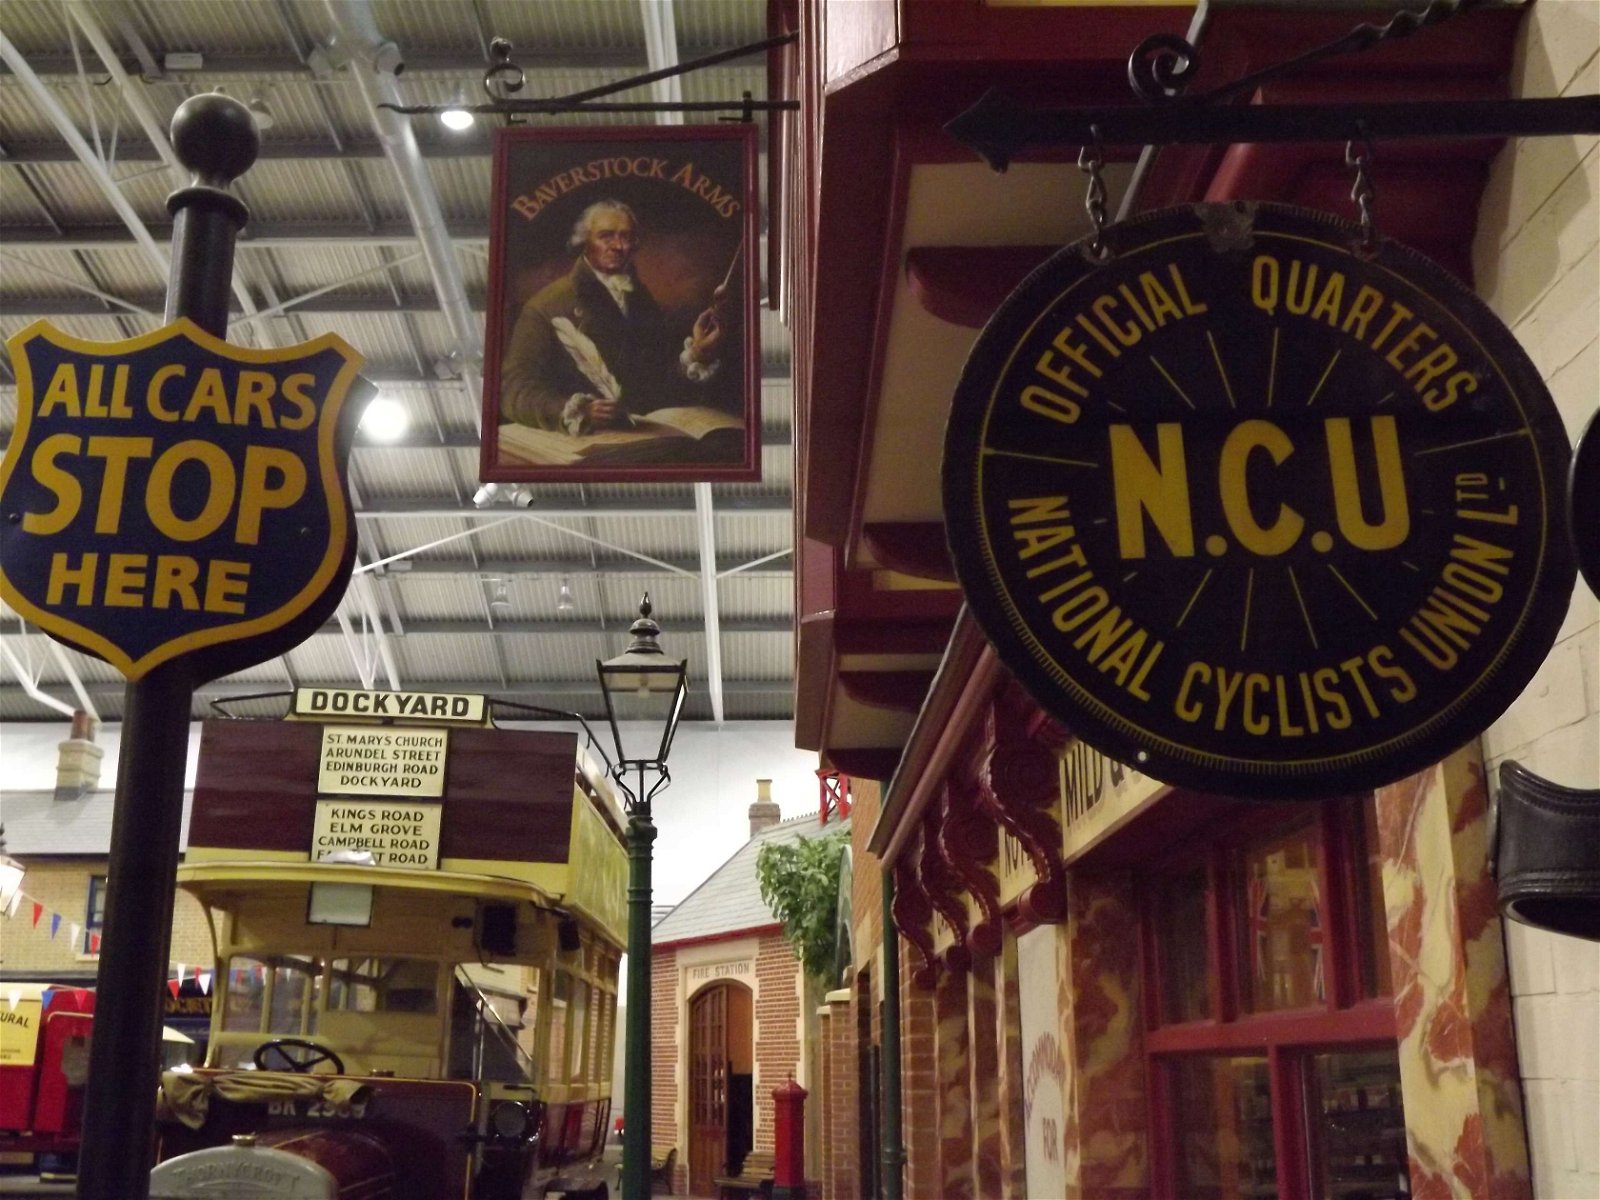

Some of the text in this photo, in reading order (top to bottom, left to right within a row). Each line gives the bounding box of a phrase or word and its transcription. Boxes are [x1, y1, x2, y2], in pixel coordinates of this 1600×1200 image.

[510, 156, 741, 222] BAVERSTOCK ARMS
[1020, 255, 1478, 425] OFFICIAL QUARTERS
[37, 363, 317, 430] ALL CARS
[21, 432, 308, 546] STOP
[45, 553, 251, 615] HERE
[1007, 495, 1165, 702] NATIONAL
[1174, 644, 1418, 738] CYCLISTS
[1398, 534, 1515, 672] UNION
[310, 691, 470, 717] DOCKYARD
[395, 736, 443, 748] CHURCH
[325, 747, 441, 762] ARUNDEL STREET
[325, 761, 439, 775] EDINBURGH ROAD
[340, 775, 422, 789] DOCKYARD
[1063, 743, 1104, 828] MILD
[331, 808, 425, 822] KINGS ROAD
[330, 822, 422, 837] ELM GROVE
[318, 835, 430, 851] CAMPBELL ROAD
[388, 852, 428, 865] ROAD
[693, 962, 749, 979] FIRE STATION
[0, 1011, 30, 1029] URAL
